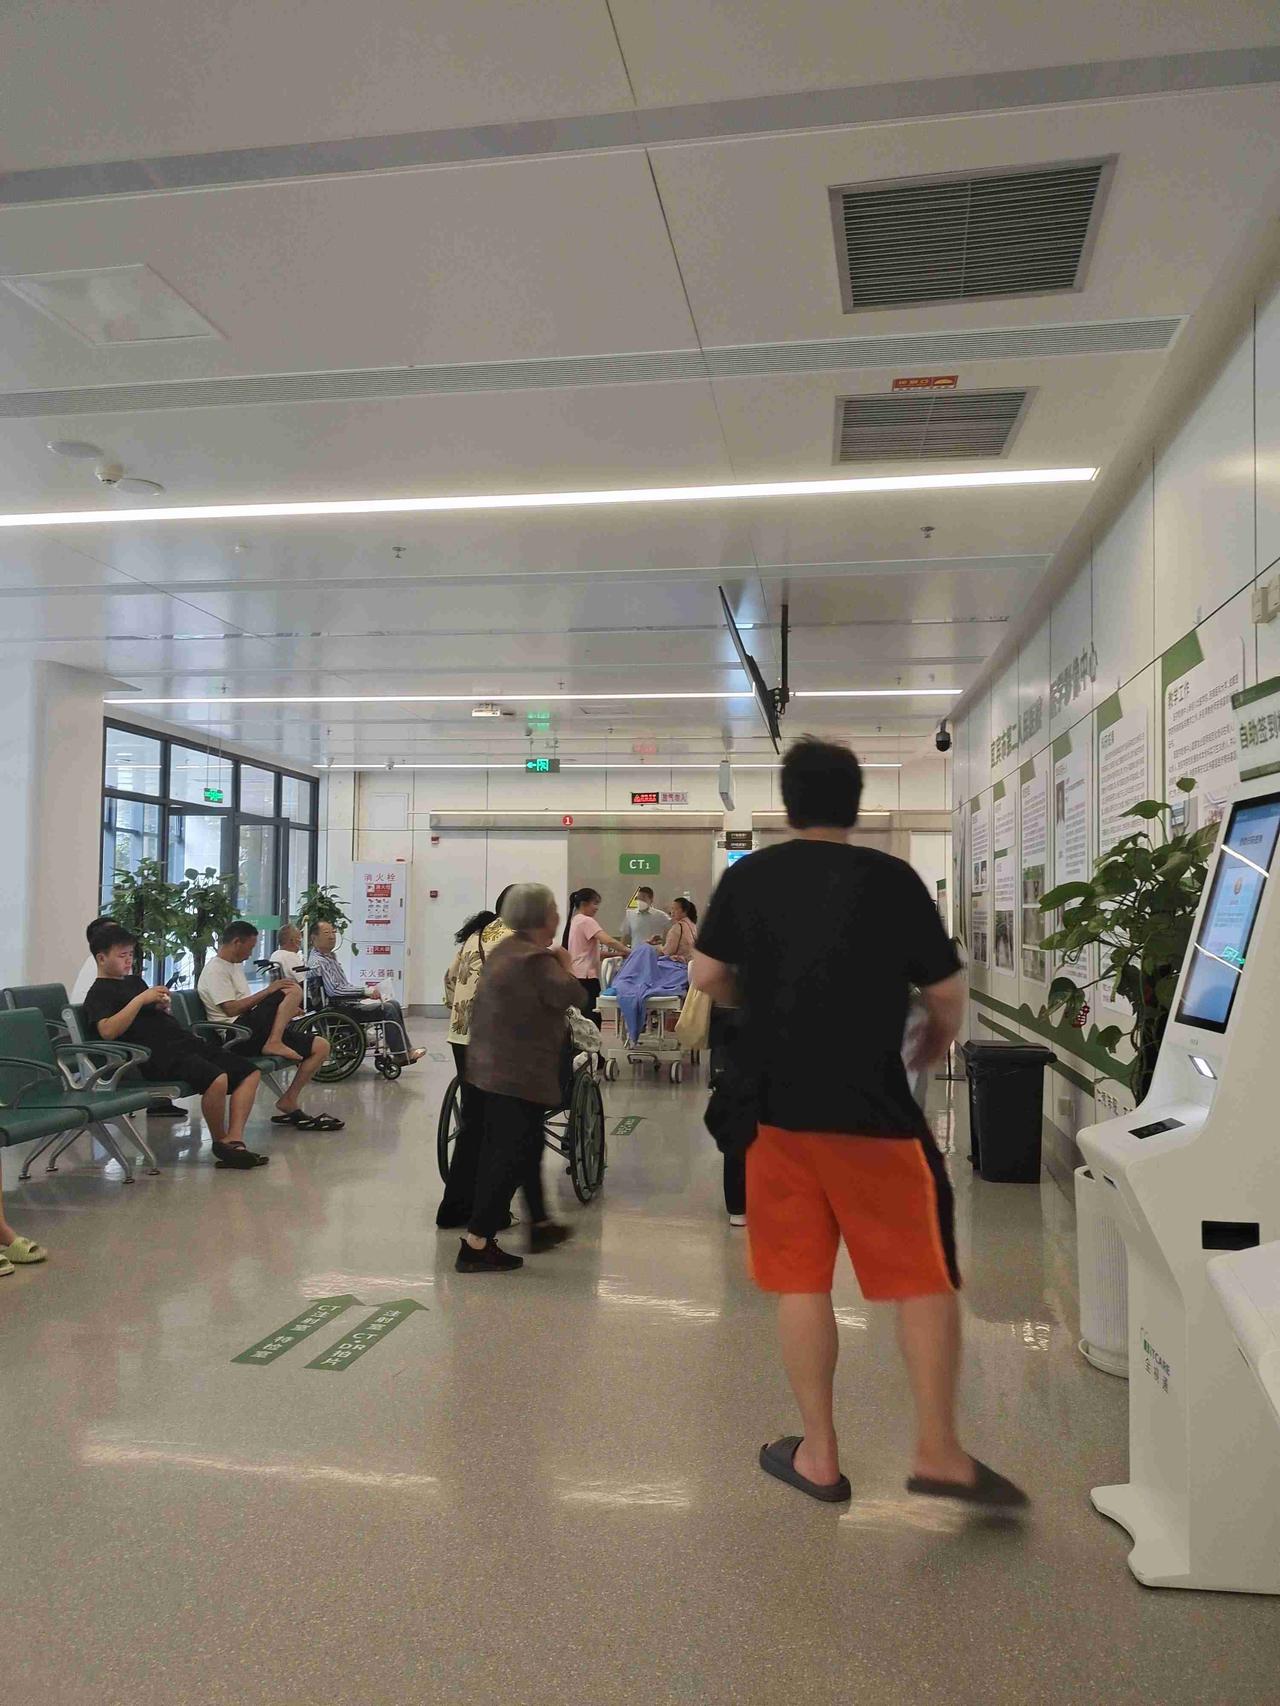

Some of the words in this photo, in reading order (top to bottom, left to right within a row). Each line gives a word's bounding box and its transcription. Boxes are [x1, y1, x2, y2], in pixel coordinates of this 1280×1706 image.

[363, 873, 396, 882] 消火栓
[359, 969, 395, 978] 灭火器箱
